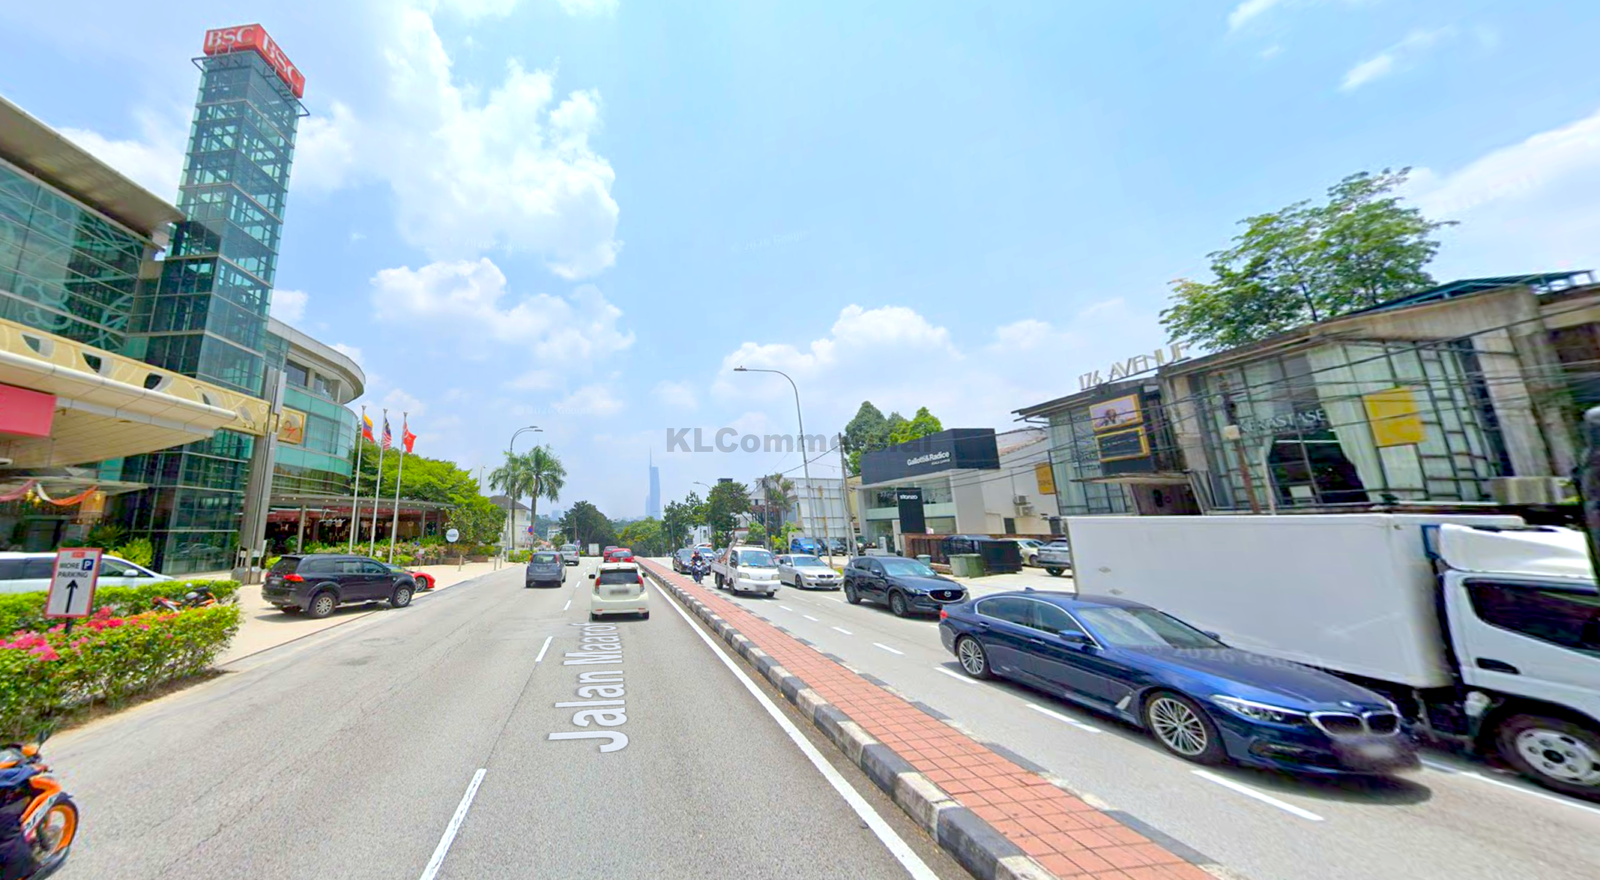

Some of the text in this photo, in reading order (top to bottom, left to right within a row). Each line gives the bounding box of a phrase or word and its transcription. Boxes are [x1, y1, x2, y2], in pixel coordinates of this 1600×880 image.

[207, 26, 254, 48] BSC
[262, 33, 303, 91] BSC
[1079, 369, 1103, 390] 176
